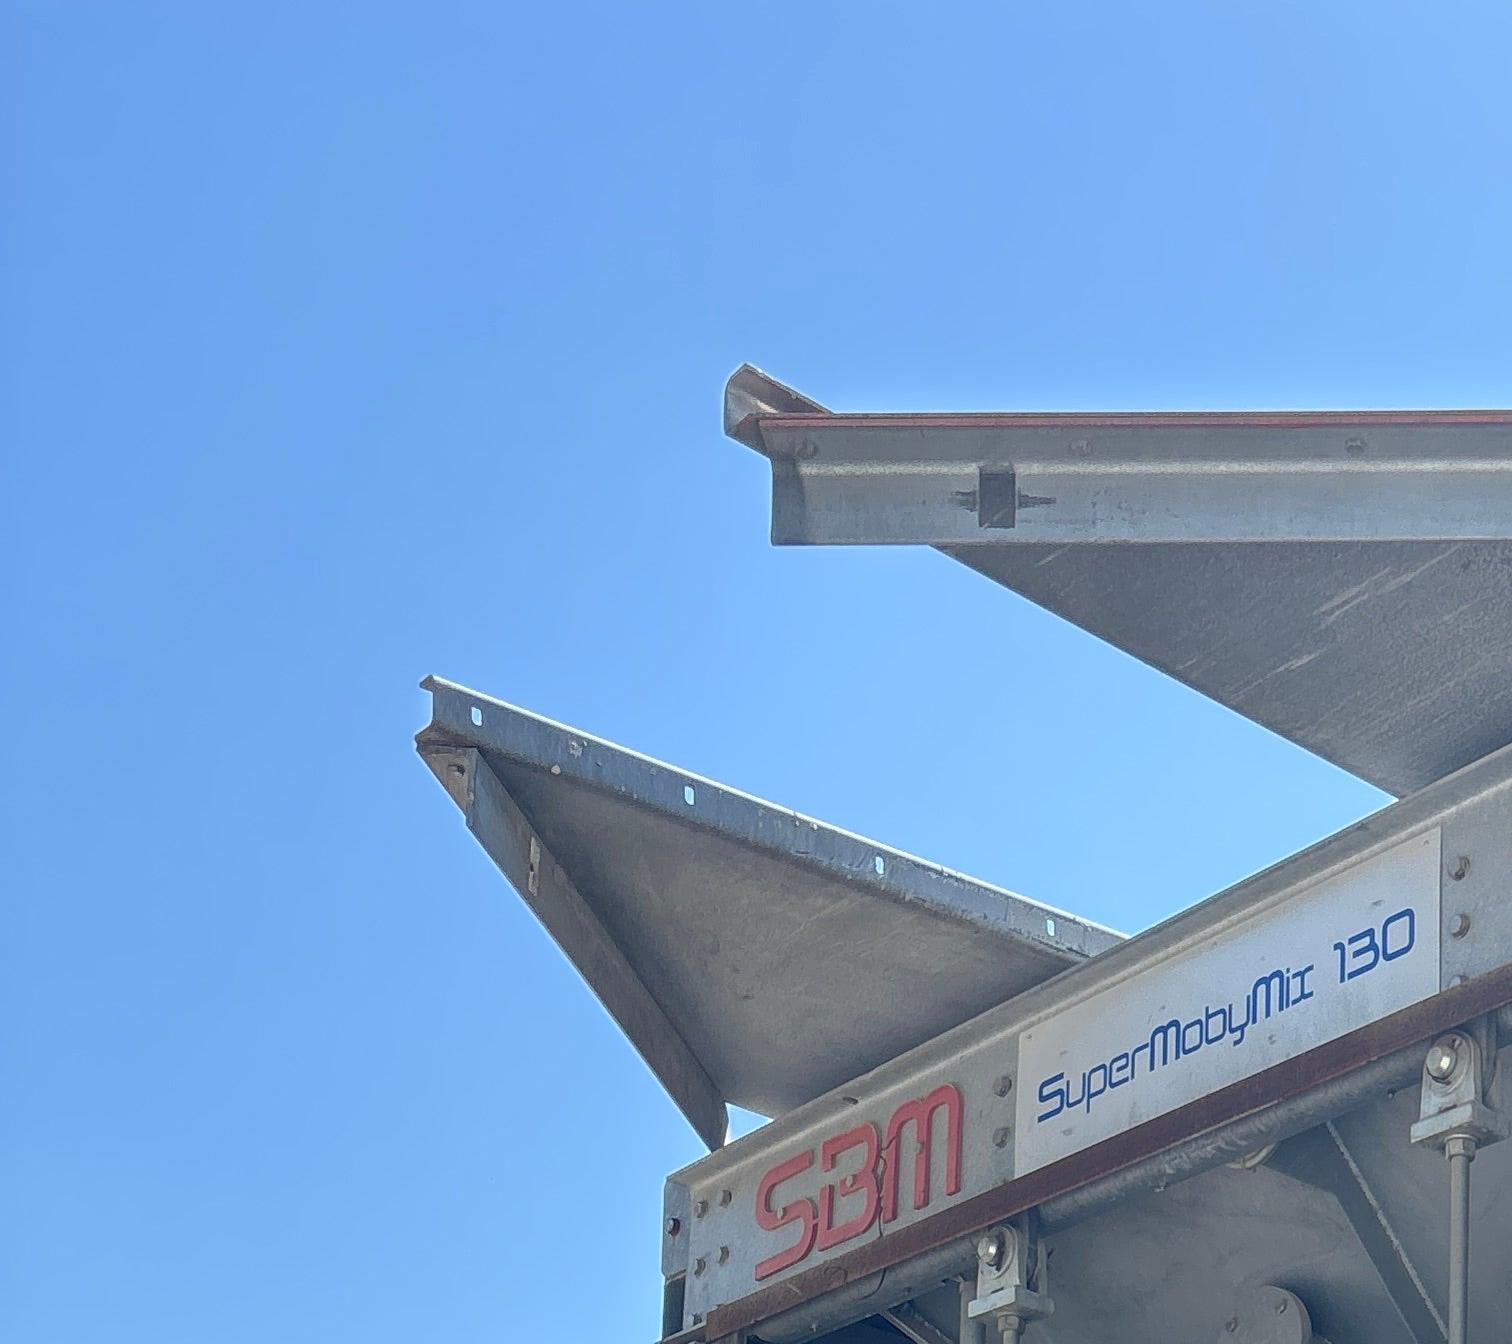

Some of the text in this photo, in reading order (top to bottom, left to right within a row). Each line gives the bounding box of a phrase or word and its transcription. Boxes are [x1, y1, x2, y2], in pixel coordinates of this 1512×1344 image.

[1037, 908, 1416, 1124] SuperMobyMix 130
[755, 1083, 964, 1281] SBM
